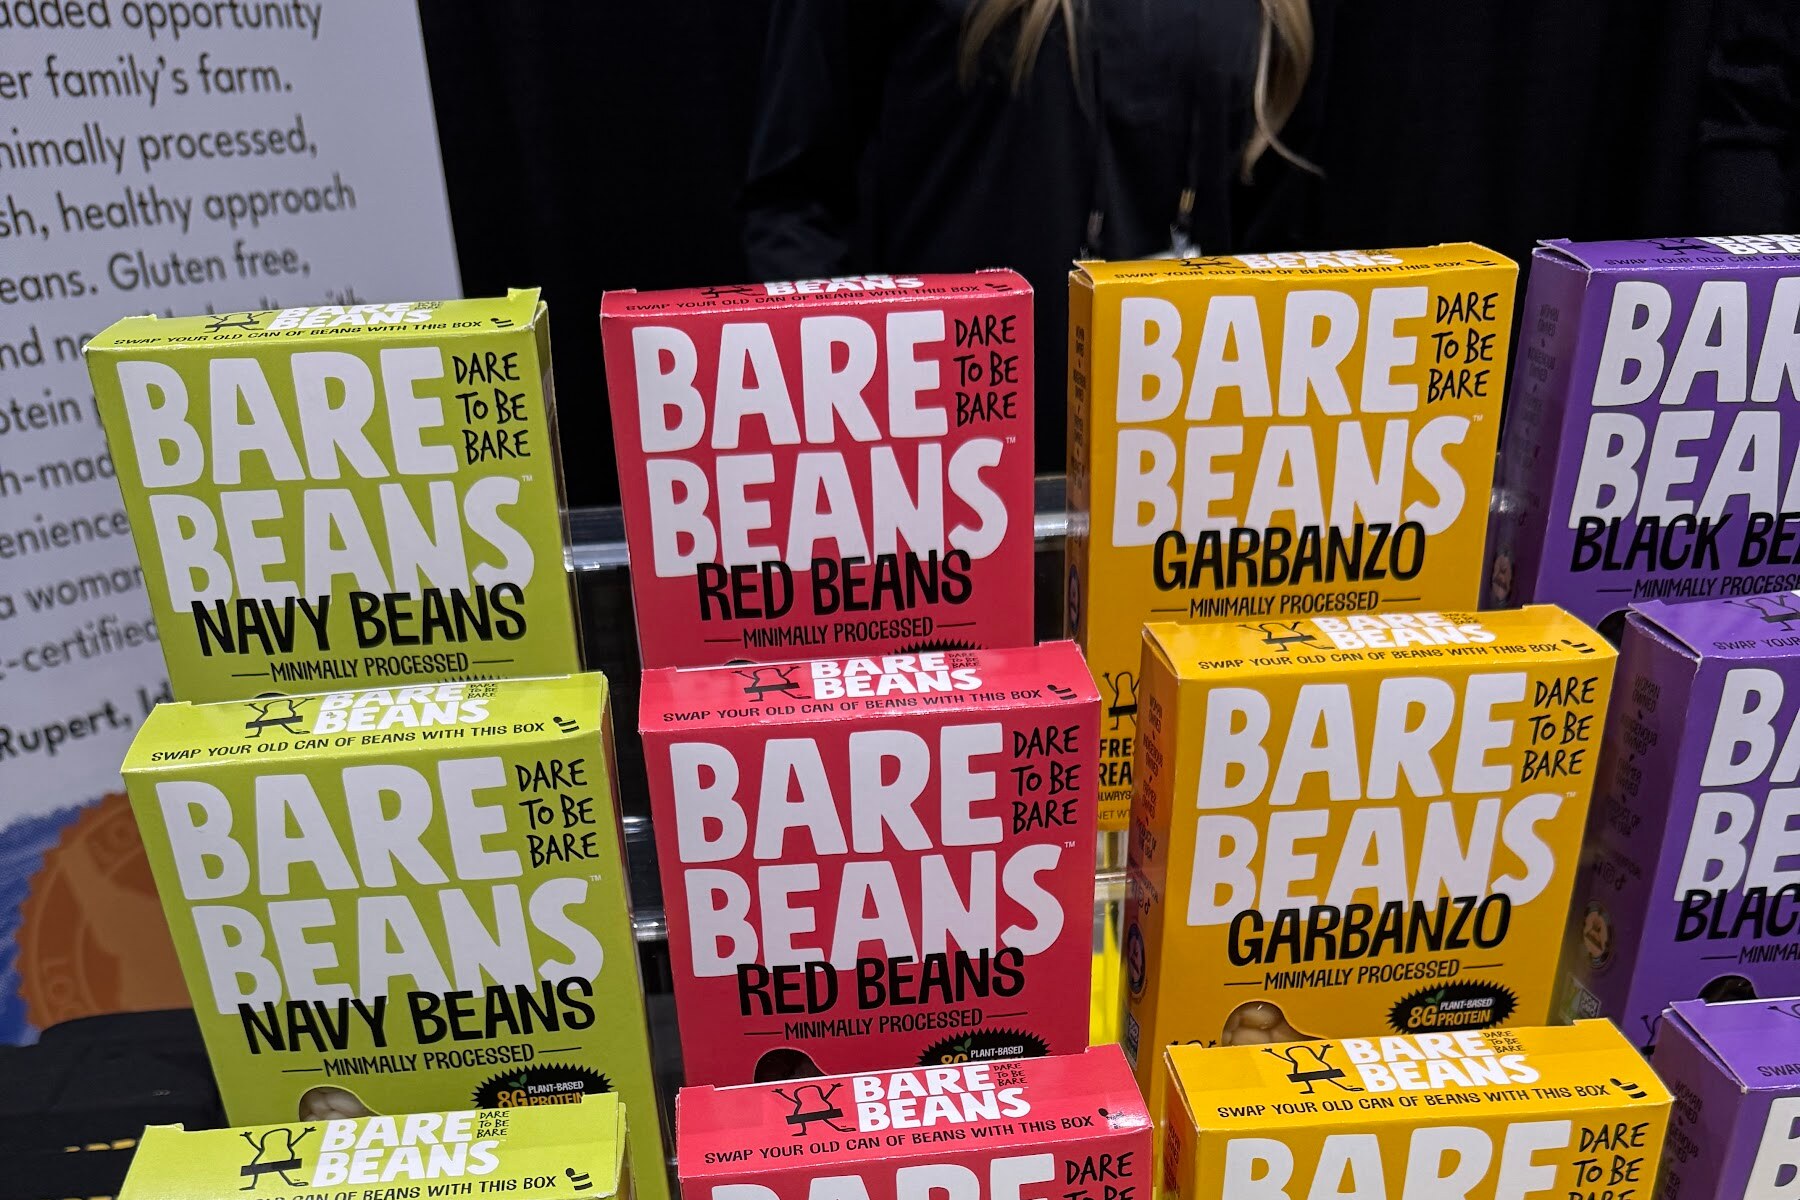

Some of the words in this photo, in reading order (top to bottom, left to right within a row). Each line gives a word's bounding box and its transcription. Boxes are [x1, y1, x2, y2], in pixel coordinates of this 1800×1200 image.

[122, 0, 322, 40] opportunity
[45, 52, 188, 108] family's
[198, 53, 292, 95] farm.
[139, 115, 318, 173] processed,
[55, 184, 192, 235] healthy
[204, 172, 356, 227] approach
[108, 250, 226, 292] Gluten
[234, 241, 311, 278] free,
[989, 351, 1019, 385] BE
[1115, 286, 1429, 423] BARE
[1435, 291, 1499, 325] DARE
[1463, 332, 1496, 363] BE
[495, 393, 528, 424] BE
[631, 309, 949, 453] BARE
[954, 314, 1017, 346] DARE
[955, 391, 1018, 427] BARE
[1427, 368, 1491, 404] BARE
[116, 346, 459, 488] BARE
[452, 351, 521, 385] DARE
[462, 429, 532, 466] BARE
[646, 437, 1008, 577] BEANS
[1112, 415, 1470, 547] BEANS
[148, 475, 535, 613] BEANS
[1152, 520, 1427, 592] GARBANZO
[1569, 512, 1733, 573] BLACK
[697, 559, 794, 622] RED
[809, 548, 973, 616] BEANS
[1190, 594, 1275, 618] MINIMALLY
[1279, 590, 1379, 615] PROCESSED
[1632, 576, 1717, 598] MINIMALLY
[190, 594, 331, 657] NAVY
[348, 581, 528, 653] BEANS
[742, 626, 826, 649] MINIMALLY
[833, 616, 934, 644] PROCESSED
[270, 658, 358, 683] MINIMALLY
[364, 652, 469, 677] PROCESSED
[151, 748, 201, 764] SWAP
[207, 744, 252, 758] YOUR
[257, 740, 289, 754] OLD
[293, 737, 329, 751] CAN
[334, 735, 356, 747] OF
[361, 731, 417, 746] BEANS
[422, 727, 466, 741] WITH
[470, 723, 508, 737] THIS
[512, 721, 545, 735] BOX
[1196, 672, 1528, 811] BARE
[669, 722, 1004, 864] BARE
[155, 756, 524, 901] BARE
[1186, 792, 1563, 927] BEANS
[684, 843, 1066, 978] BEANS
[1227, 892, 1513, 967] GARBANZO
[191, 877, 604, 1016] BEANS
[736, 960, 839, 1017] RED
[856, 946, 1027, 1010] BEANS
[1440, 997, 1493, 1010] PLANT-BASED
[236, 995, 387, 1055] NAVY
[410, 976, 597, 1045] BEANS
[1407, 1006, 1437, 1029] 8G
[1437, 1008, 1491, 1025] PROTEIN
[322, 1051, 418, 1078] MINIMALLY
[423, 1044, 535, 1071] PROCESSED
